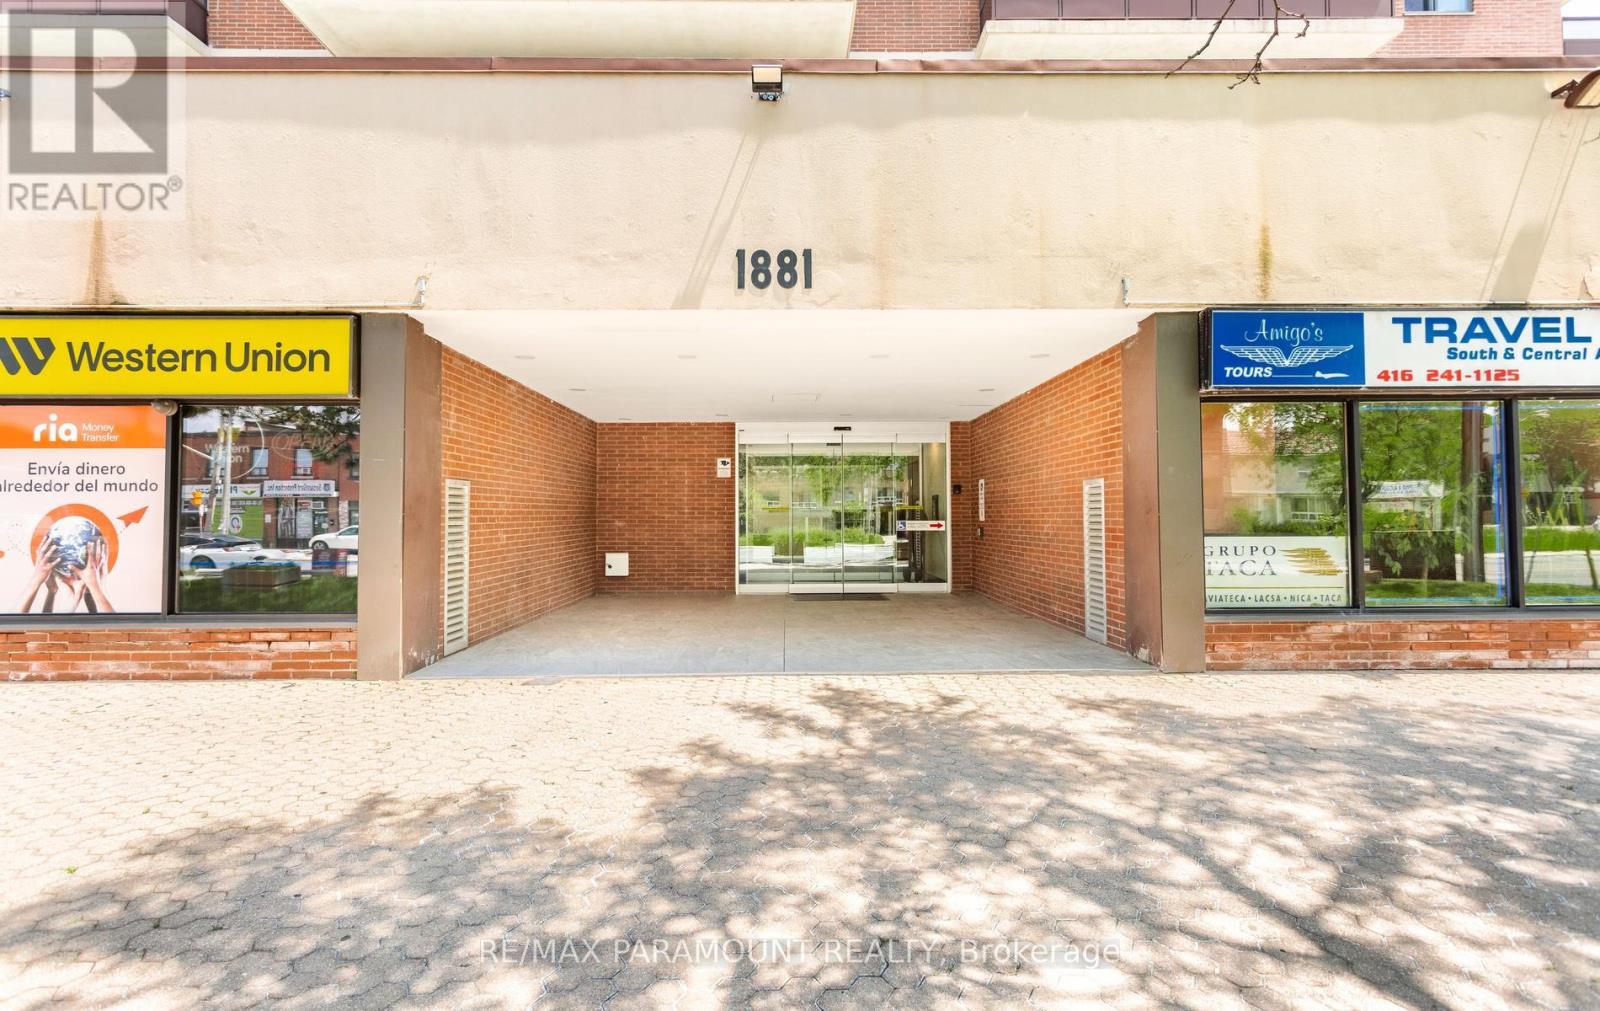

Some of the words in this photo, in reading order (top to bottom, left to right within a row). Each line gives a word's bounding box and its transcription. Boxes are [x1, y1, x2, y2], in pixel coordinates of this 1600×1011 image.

[735, 248, 813, 290] 1881
[1244, 319, 1324, 347] Amigo's
[1391, 316, 1592, 344] TRAVEL
[66, 341, 217, 373] Western
[225, 341, 330, 373] Union
[1446, 347, 1498, 360] South
[1503, 347, 1516, 360] &
[1522, 347, 1588, 360] Central
[1223, 366, 1273, 378] TOURS
[1376, 369, 1413, 382] 416
[1426, 369, 1520, 382] 241-1125
[33, 413, 78, 442] ria
[82, 423, 114, 433] Money
[82, 434, 120, 442] Transfer
[28, 461, 70, 475] Envía
[75, 462, 126, 475] dinero
[0, 479, 70, 493] lrededor
[74, 479, 98, 493] del
[103, 479, 159, 493] mundo
[1204, 545, 1277, 557] GRUPO
[1254, 594, 1281, 603] LACSA
[1290, 594, 1312, 603] NICA
[1320, 594, 1343, 603] TACA
